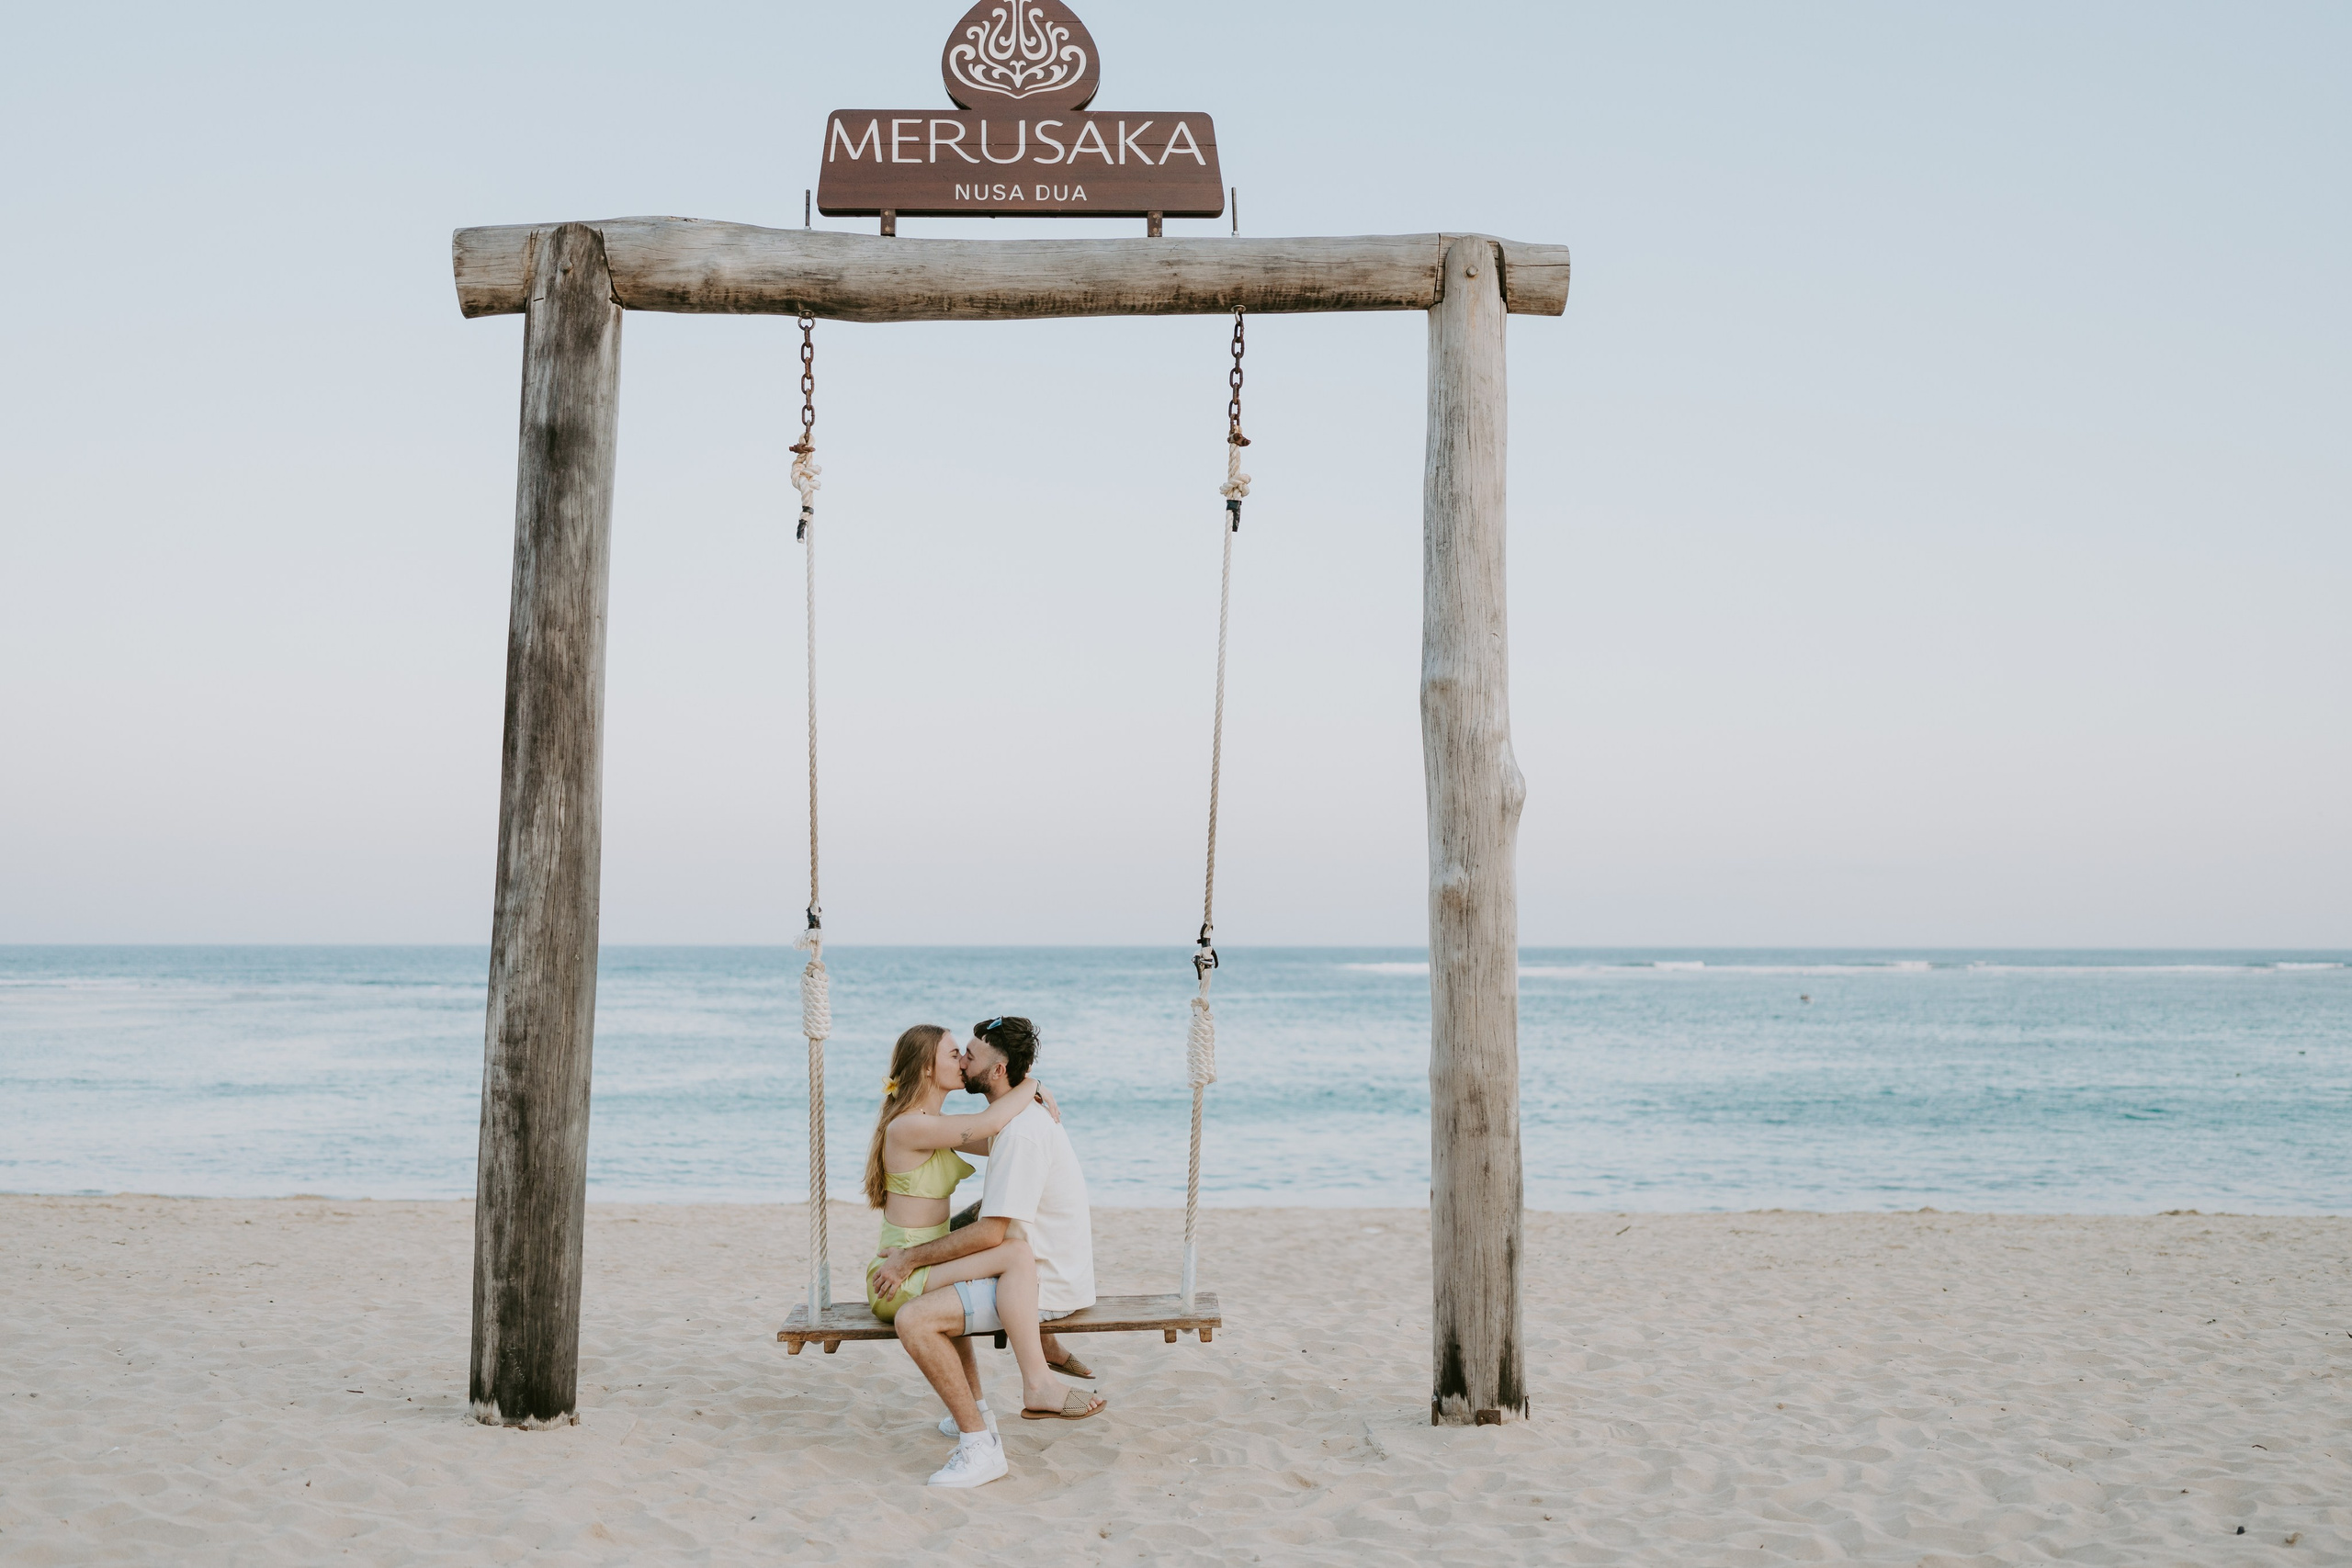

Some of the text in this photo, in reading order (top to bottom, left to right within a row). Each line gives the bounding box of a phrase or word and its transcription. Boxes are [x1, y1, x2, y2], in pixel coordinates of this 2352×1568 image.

[829, 118, 1206, 166] MERUSAKA
[956, 184, 1088, 201] NUSA DUA
